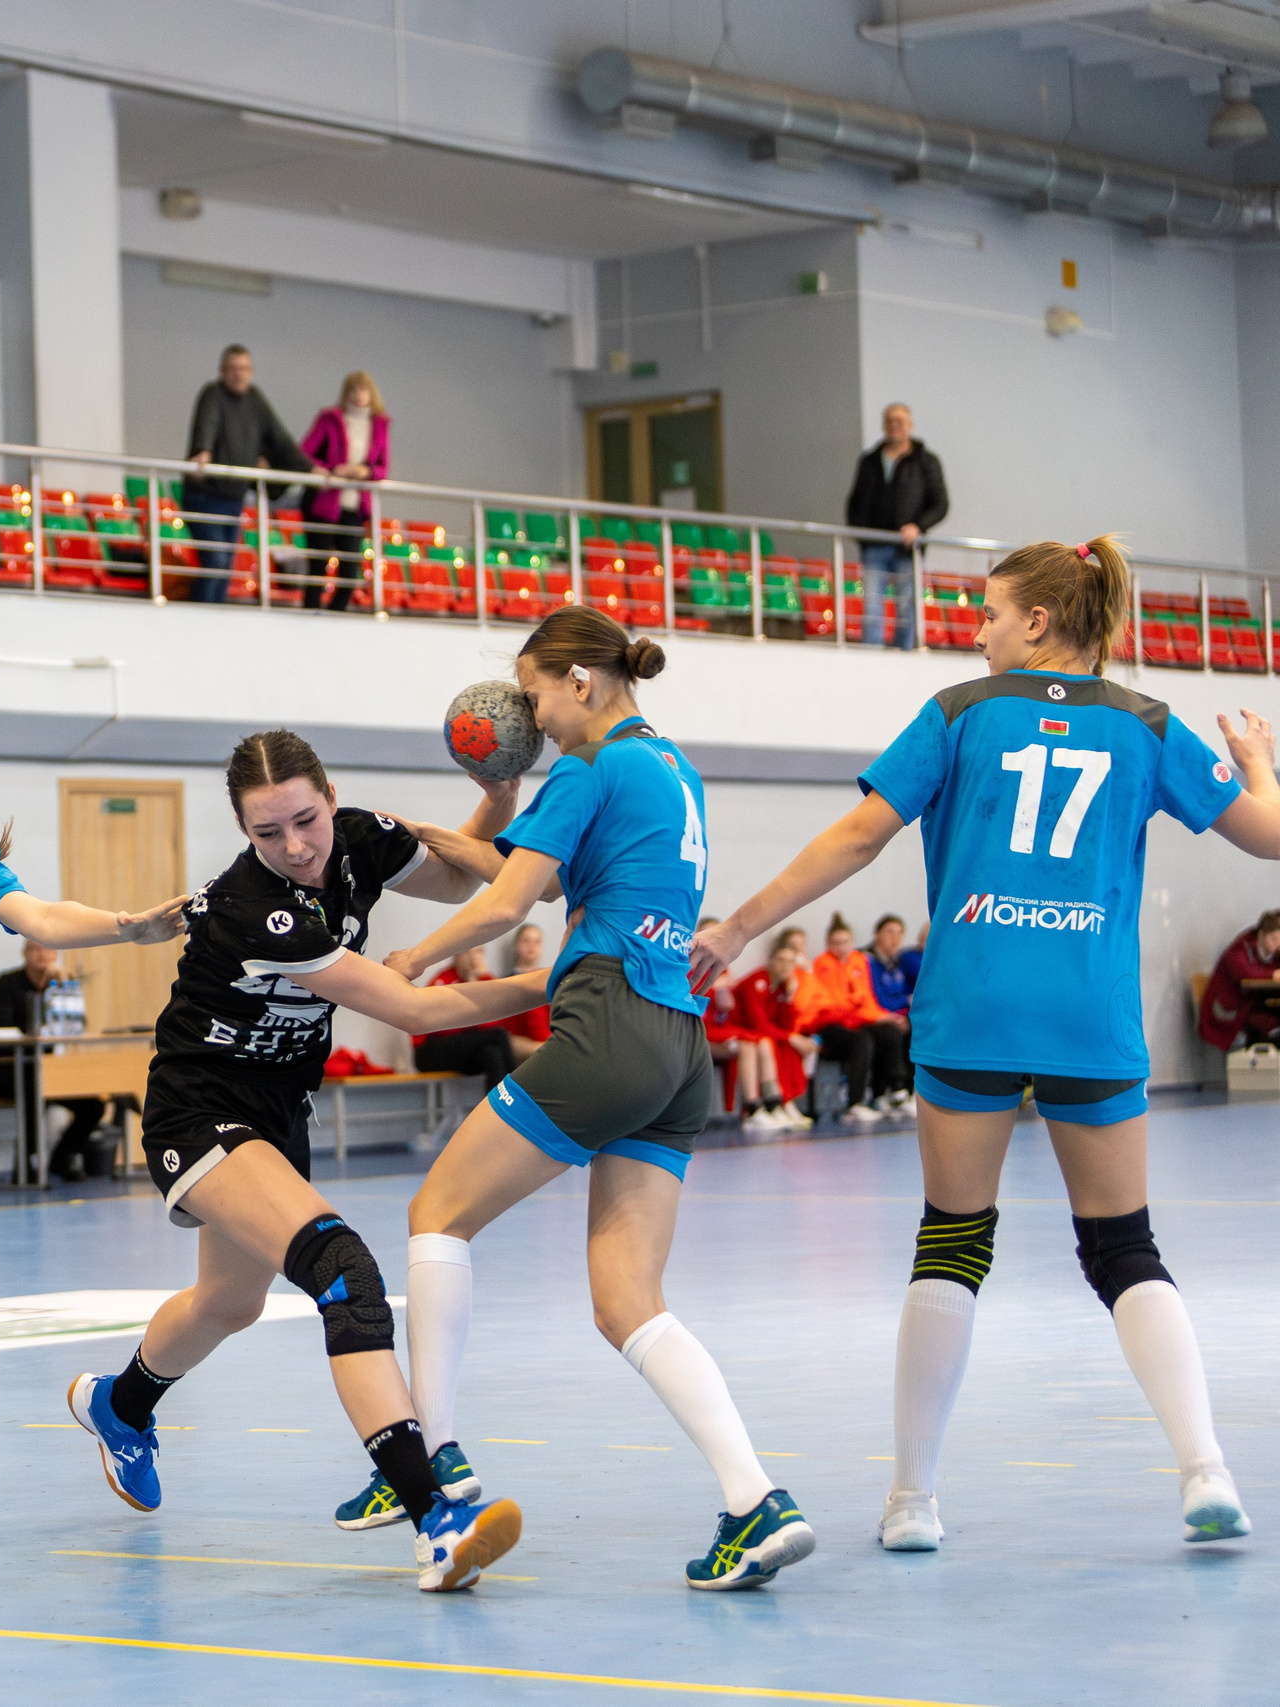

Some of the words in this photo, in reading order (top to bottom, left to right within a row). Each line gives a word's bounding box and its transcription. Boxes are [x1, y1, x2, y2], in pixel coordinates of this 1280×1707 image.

[679, 781, 707, 891] 4
[1001, 743, 1112, 859] 17
[1039, 899, 1064, 908] ЗАВОД
